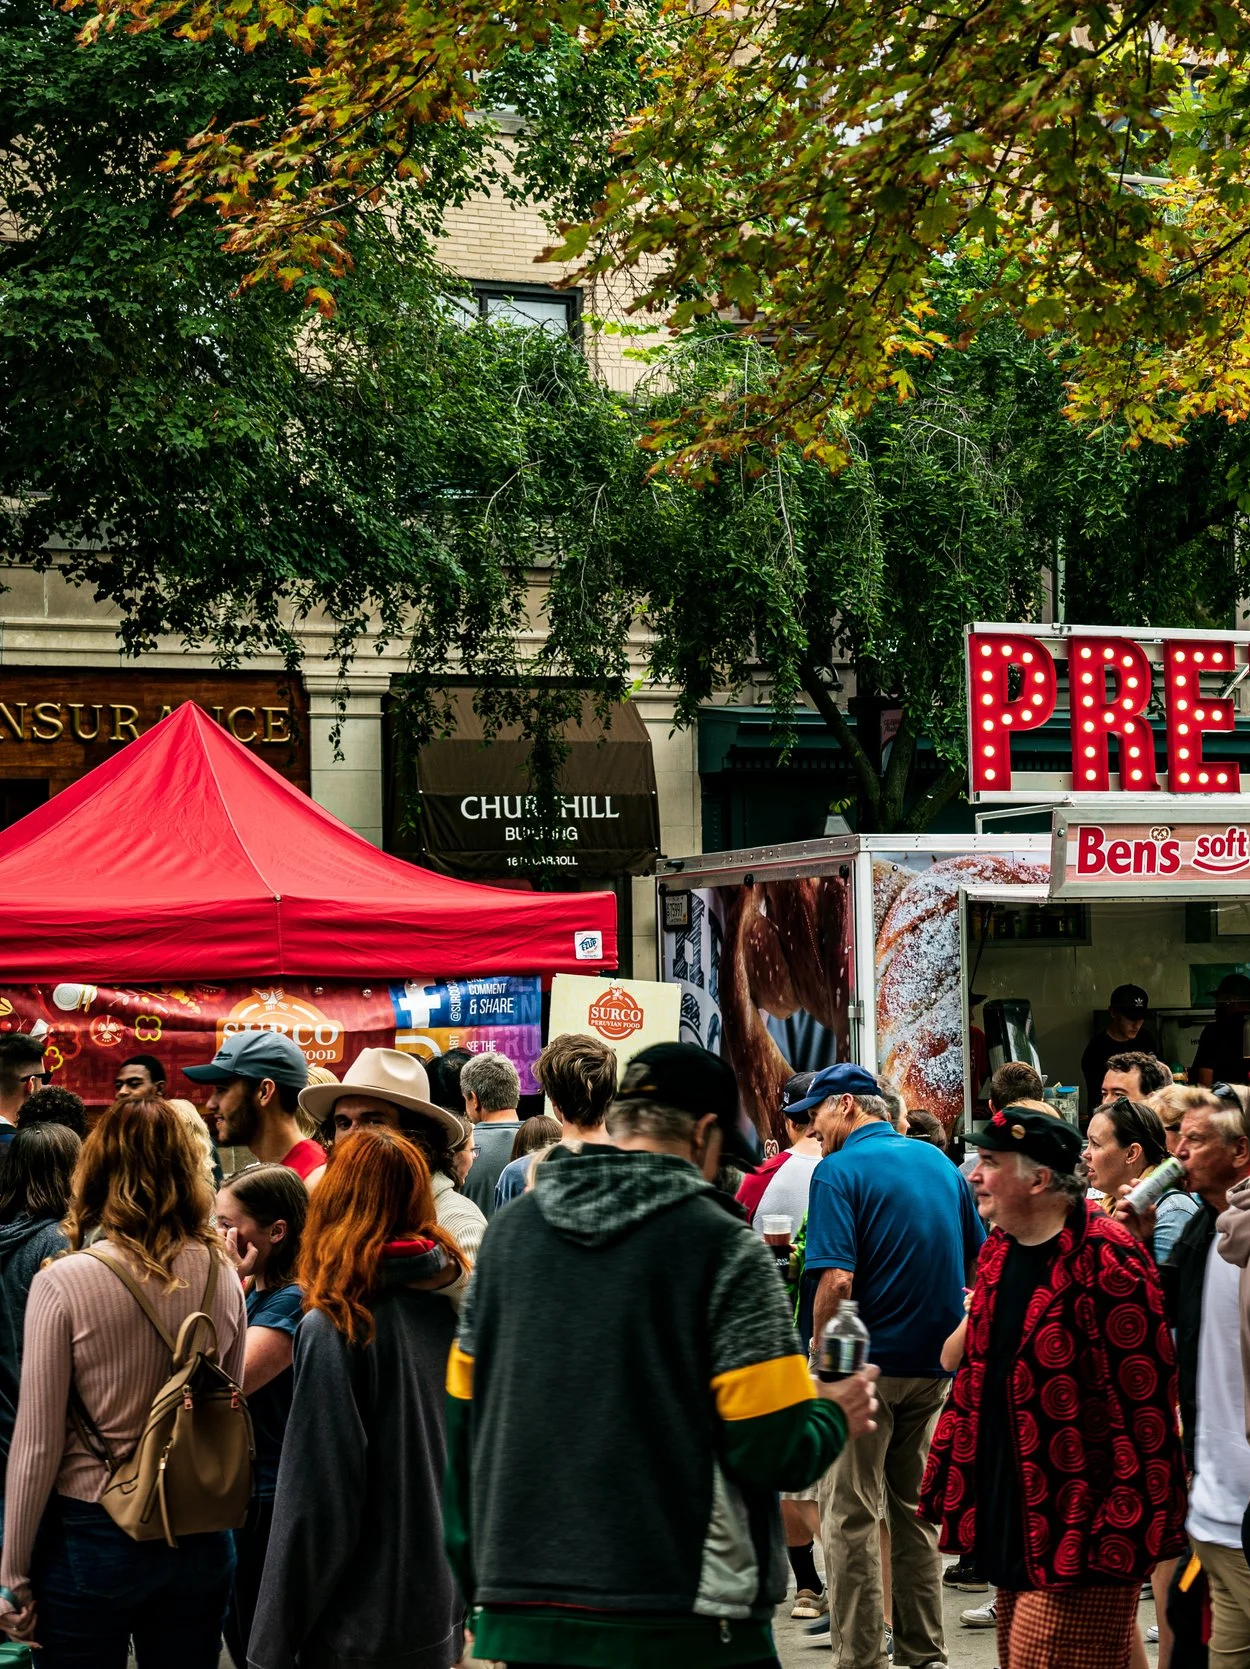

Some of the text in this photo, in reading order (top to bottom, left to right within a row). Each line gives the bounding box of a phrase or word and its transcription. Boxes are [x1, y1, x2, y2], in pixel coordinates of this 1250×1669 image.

[0, 702, 291, 743] NSURCE
[460, 795, 620, 820] CHURHILL
[1197, 828, 1248, 858] soft
[468, 983, 507, 996] COMMENT
[469, 999, 478, 1015] &
[479, 998, 514, 1014] SHARE
[590, 1006, 642, 1022] SURCO
[590, 1019, 622, 1028] PERUVIAN
[466, 1040, 497, 1053] SEE THE
